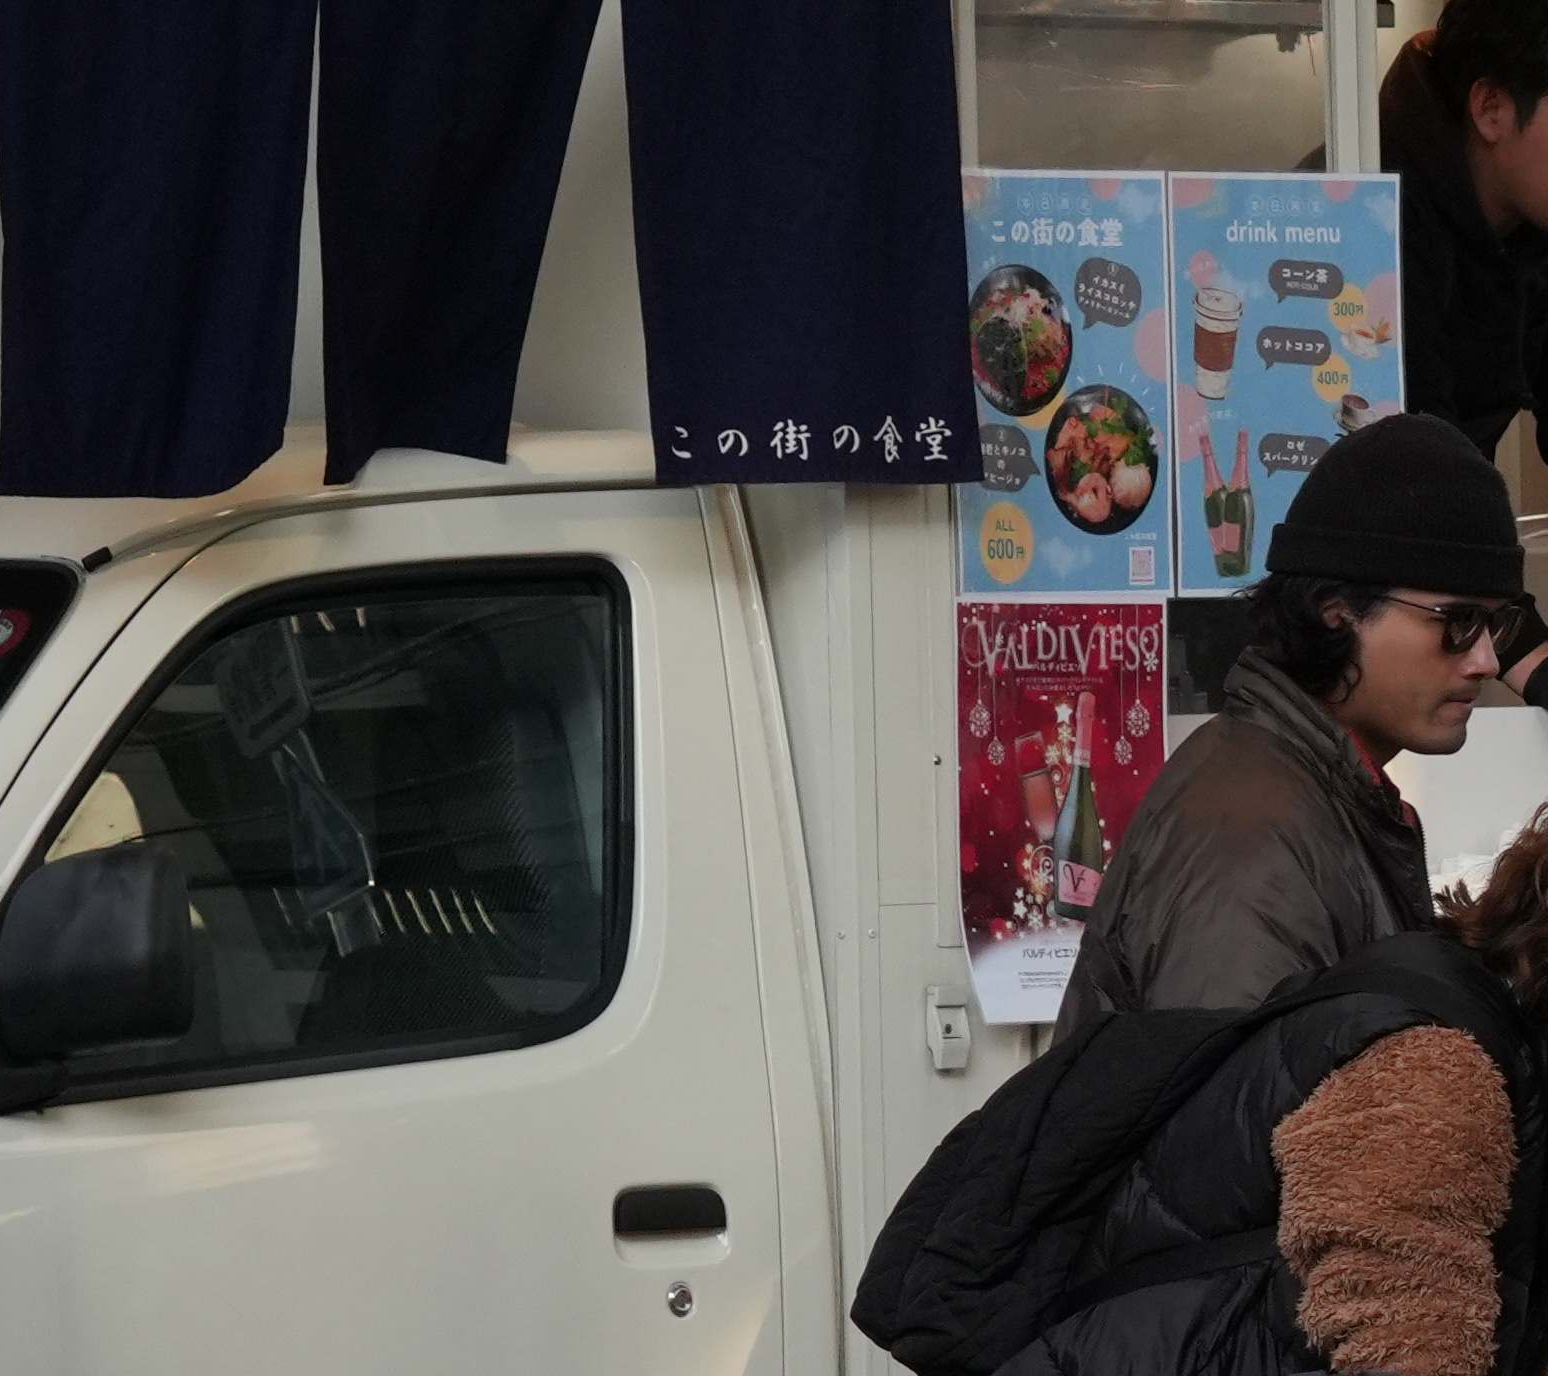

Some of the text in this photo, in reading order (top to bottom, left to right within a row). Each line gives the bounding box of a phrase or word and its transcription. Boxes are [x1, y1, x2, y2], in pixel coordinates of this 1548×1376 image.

[991, 217, 1124, 247] この街の食堂
[1226, 220, 1341, 243] drink menu
[1281, 266, 1330, 283] コーン茶
[1332, 300, 1364, 318] 300円
[1263, 336, 1325, 354] ホットココア
[1316, 370, 1349, 386] 400円
[669, 414, 952, 464] この街の食堂
[1263, 452, 1320, 467] スパークリン
[995, 519, 1016, 532] ALL
[987, 538, 1026, 560] 600円
[962, 619, 1162, 674] VALDIVIESO
